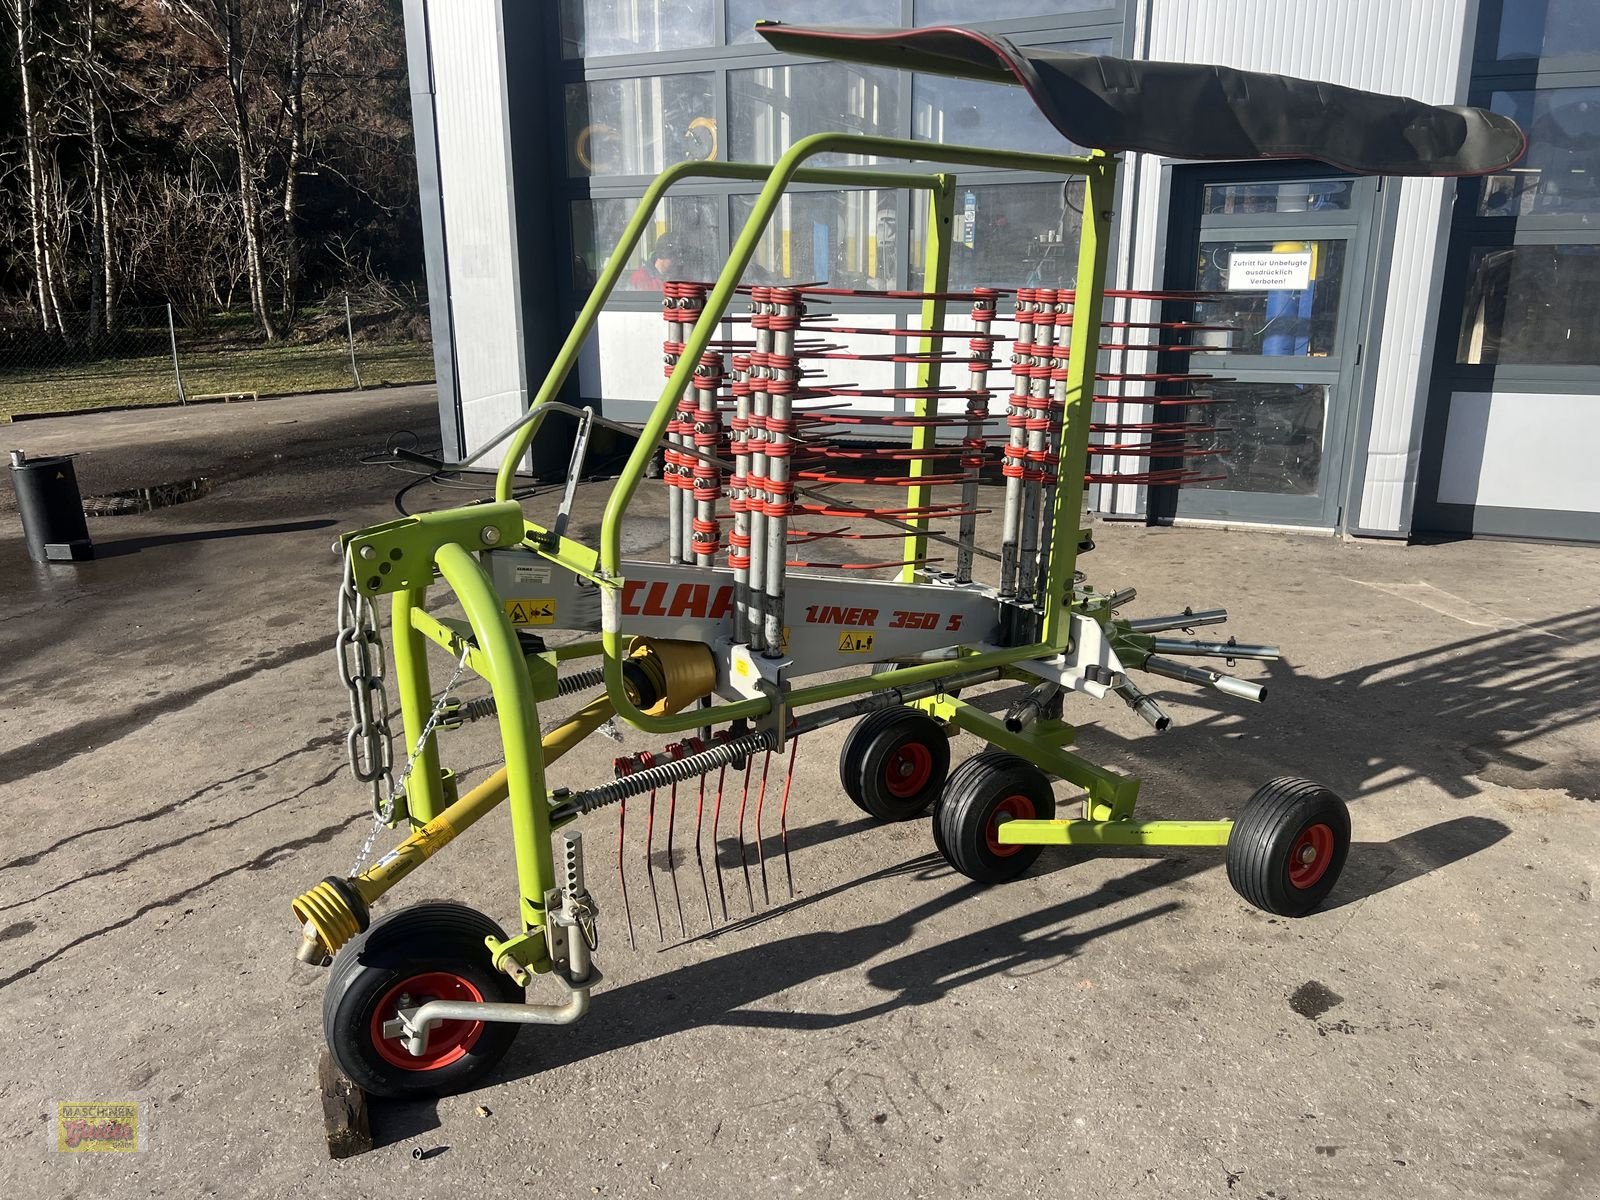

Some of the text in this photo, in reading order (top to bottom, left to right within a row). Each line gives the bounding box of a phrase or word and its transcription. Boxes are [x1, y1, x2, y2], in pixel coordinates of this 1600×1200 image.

[1269, 260, 1307, 268] Unbefugte
[621, 580, 735, 618] CLAA
[805, 605, 963, 631] LINER 350 S
